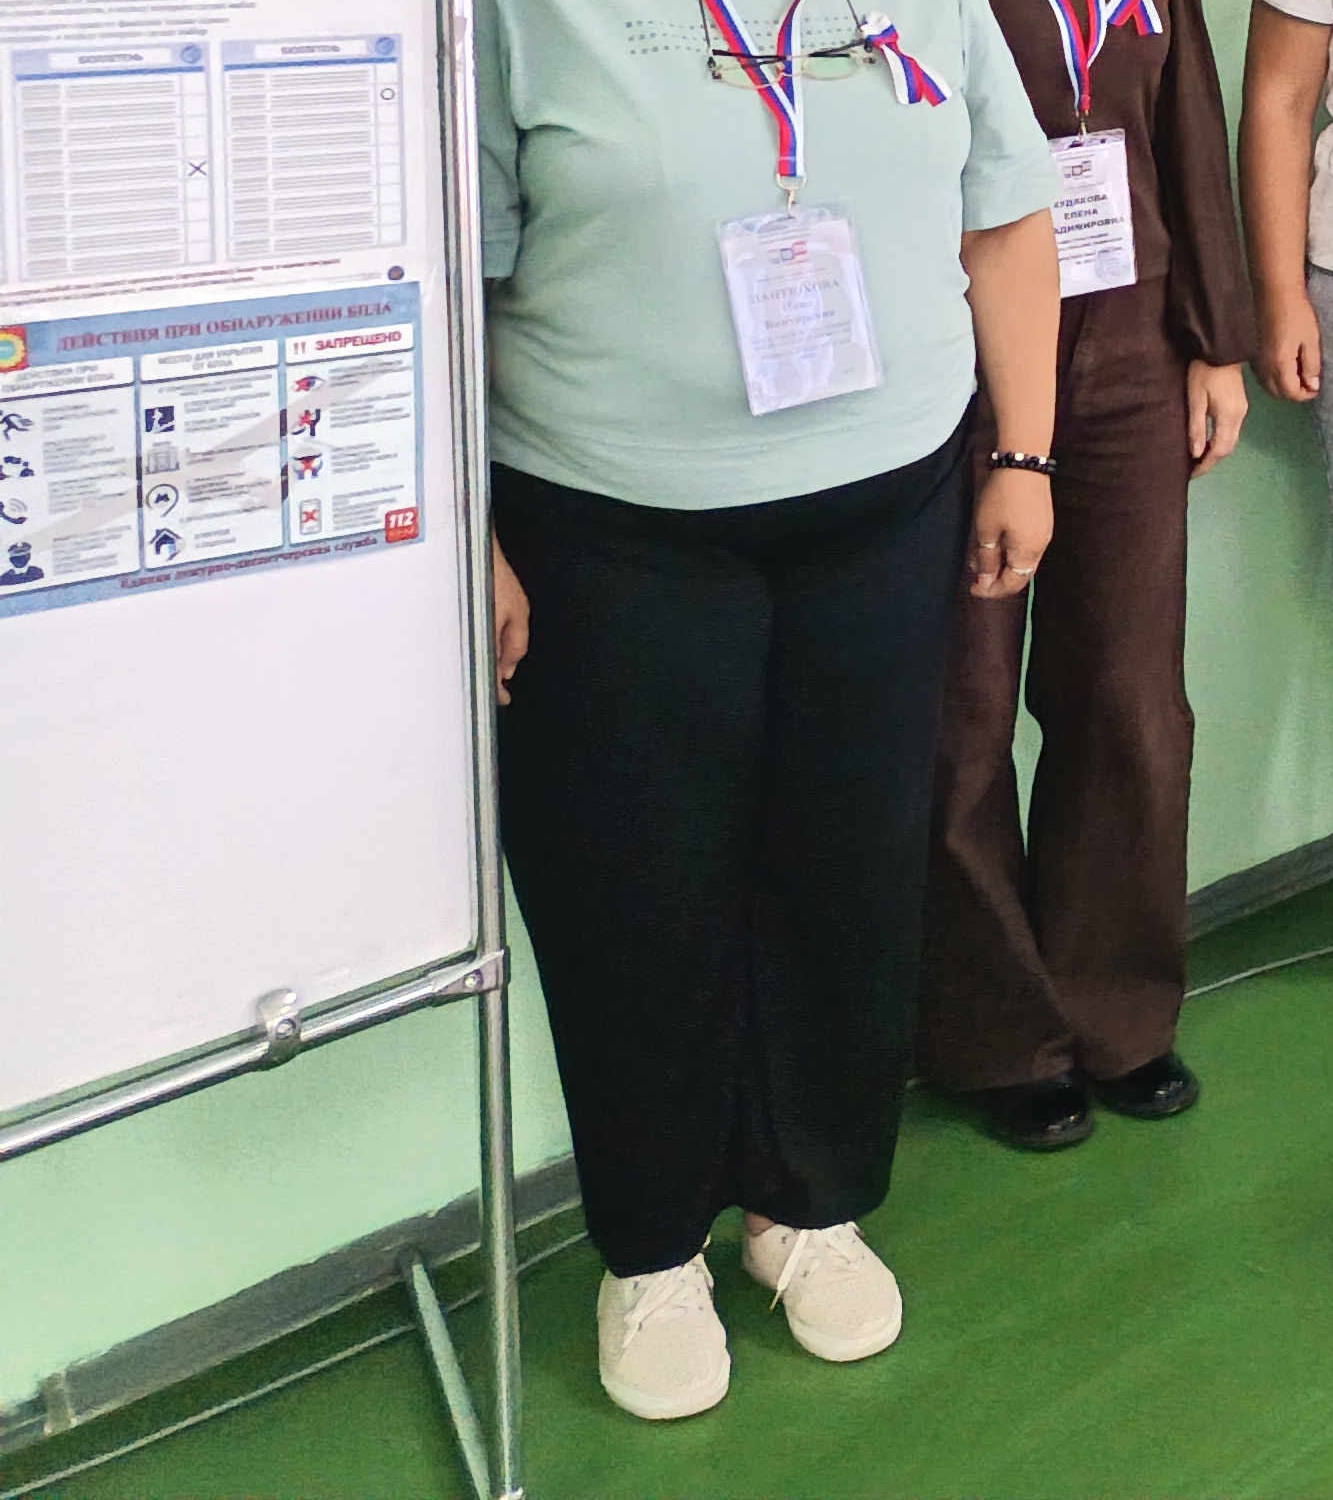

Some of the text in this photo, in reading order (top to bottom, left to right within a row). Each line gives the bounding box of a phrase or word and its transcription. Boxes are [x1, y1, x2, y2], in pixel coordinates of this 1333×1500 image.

[58, 303, 392, 351] ДЕЙСТВИЯ ПРИ ОБНАРУЖЕНИИ БПЛА
[314, 330, 402, 351] ЗАПРЕЩЕНО
[388, 511, 415, 528] 112
